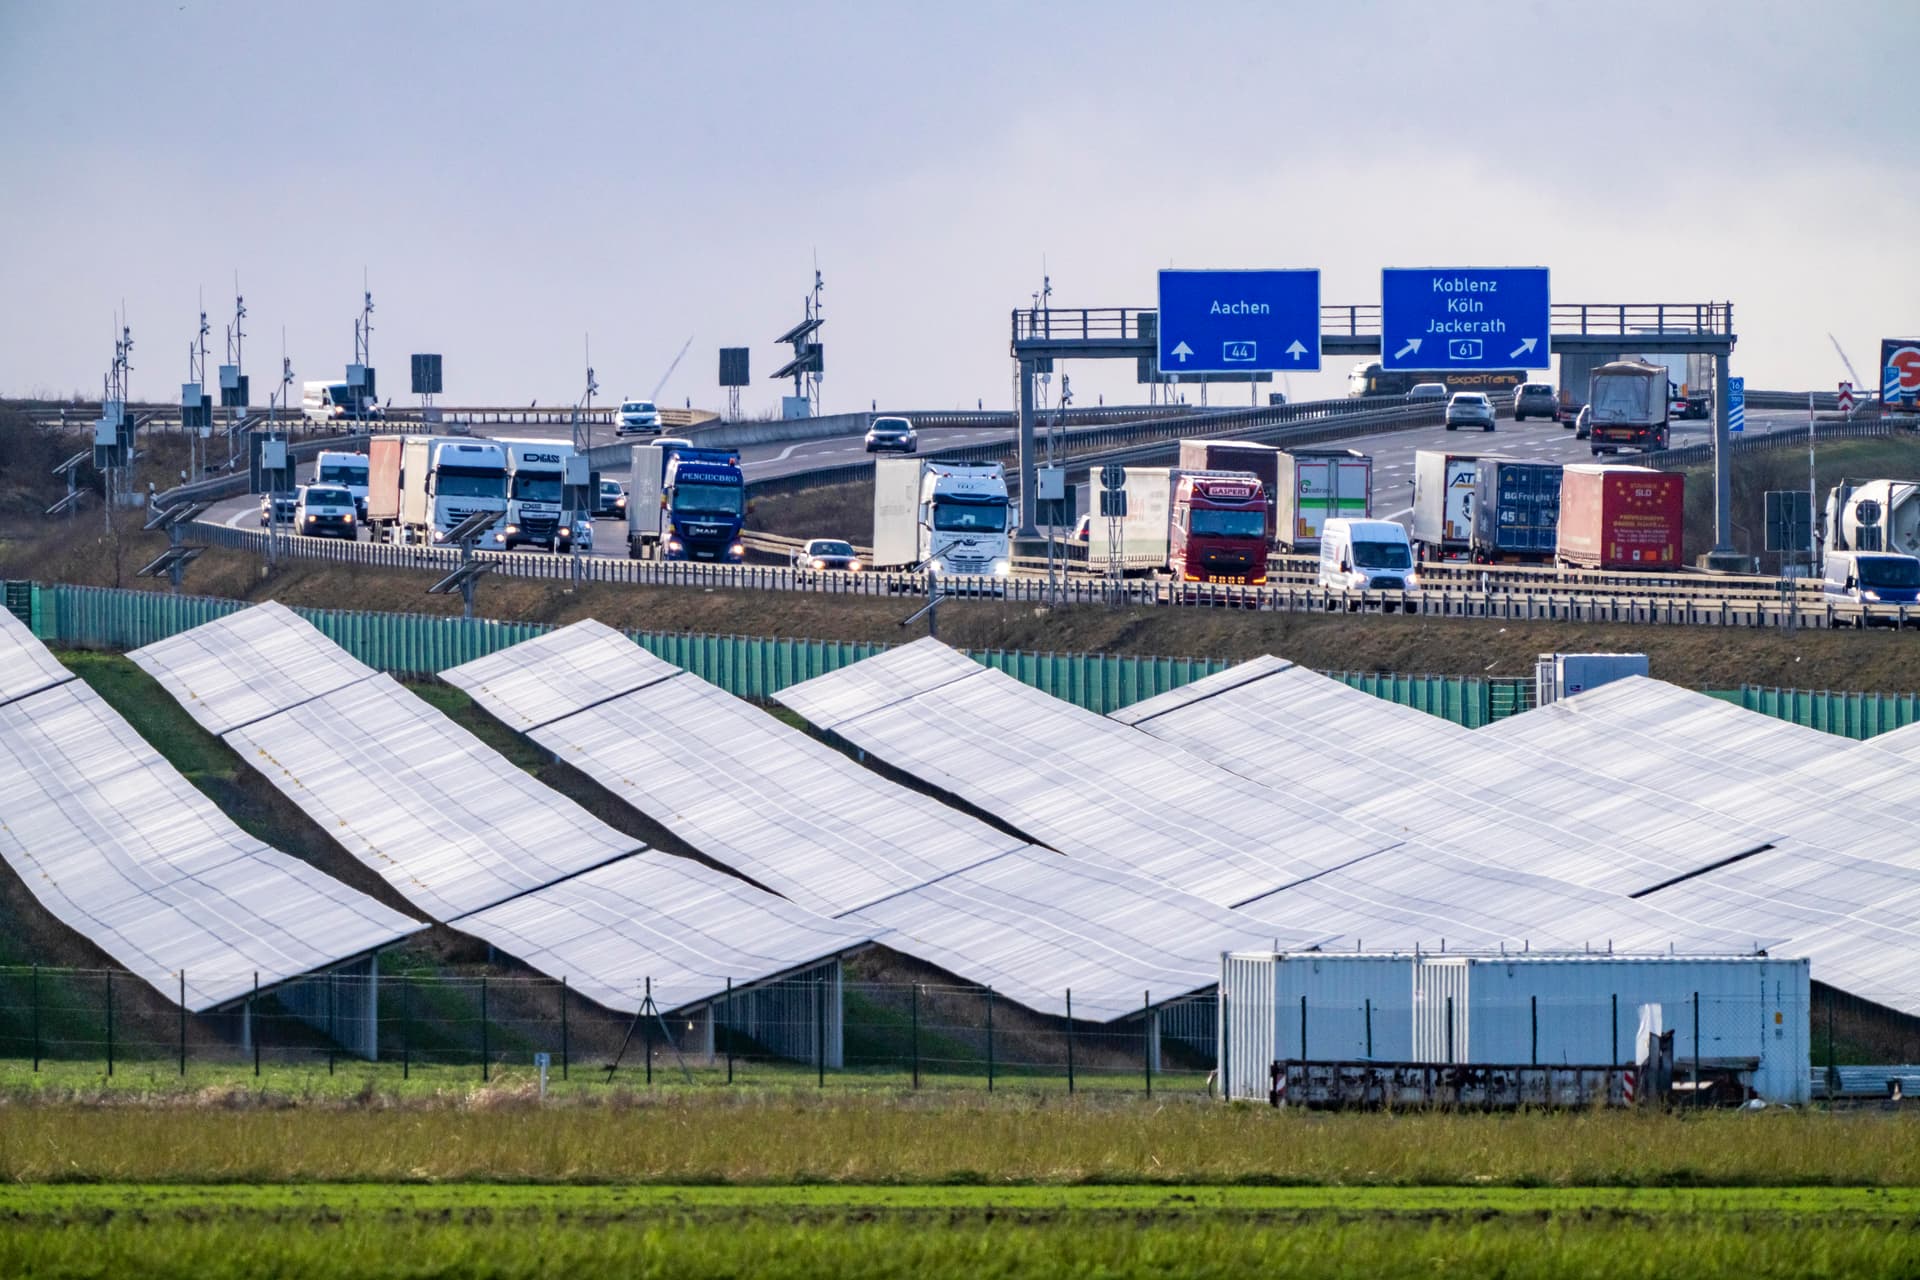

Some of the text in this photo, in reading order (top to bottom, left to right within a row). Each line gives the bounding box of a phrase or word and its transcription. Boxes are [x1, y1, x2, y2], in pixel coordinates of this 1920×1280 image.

[1433, 278, 1497, 292] Koblenz
[1210, 300, 1270, 314] Aachen
[1448, 298, 1484, 312] Köln
[1426, 319, 1506, 333] Jackerath
[1232, 345, 1248, 357] 44
[1459, 344, 1473, 355] 61
[1447, 374, 1518, 385] ExpoTrans
[1732, 381, 1741, 390] 16
[1211, 488, 1248, 496] GASPERS
[1504, 491, 1517, 500] BG
[1518, 491, 1550, 502] Freight
[1501, 511, 1515, 522] 45
